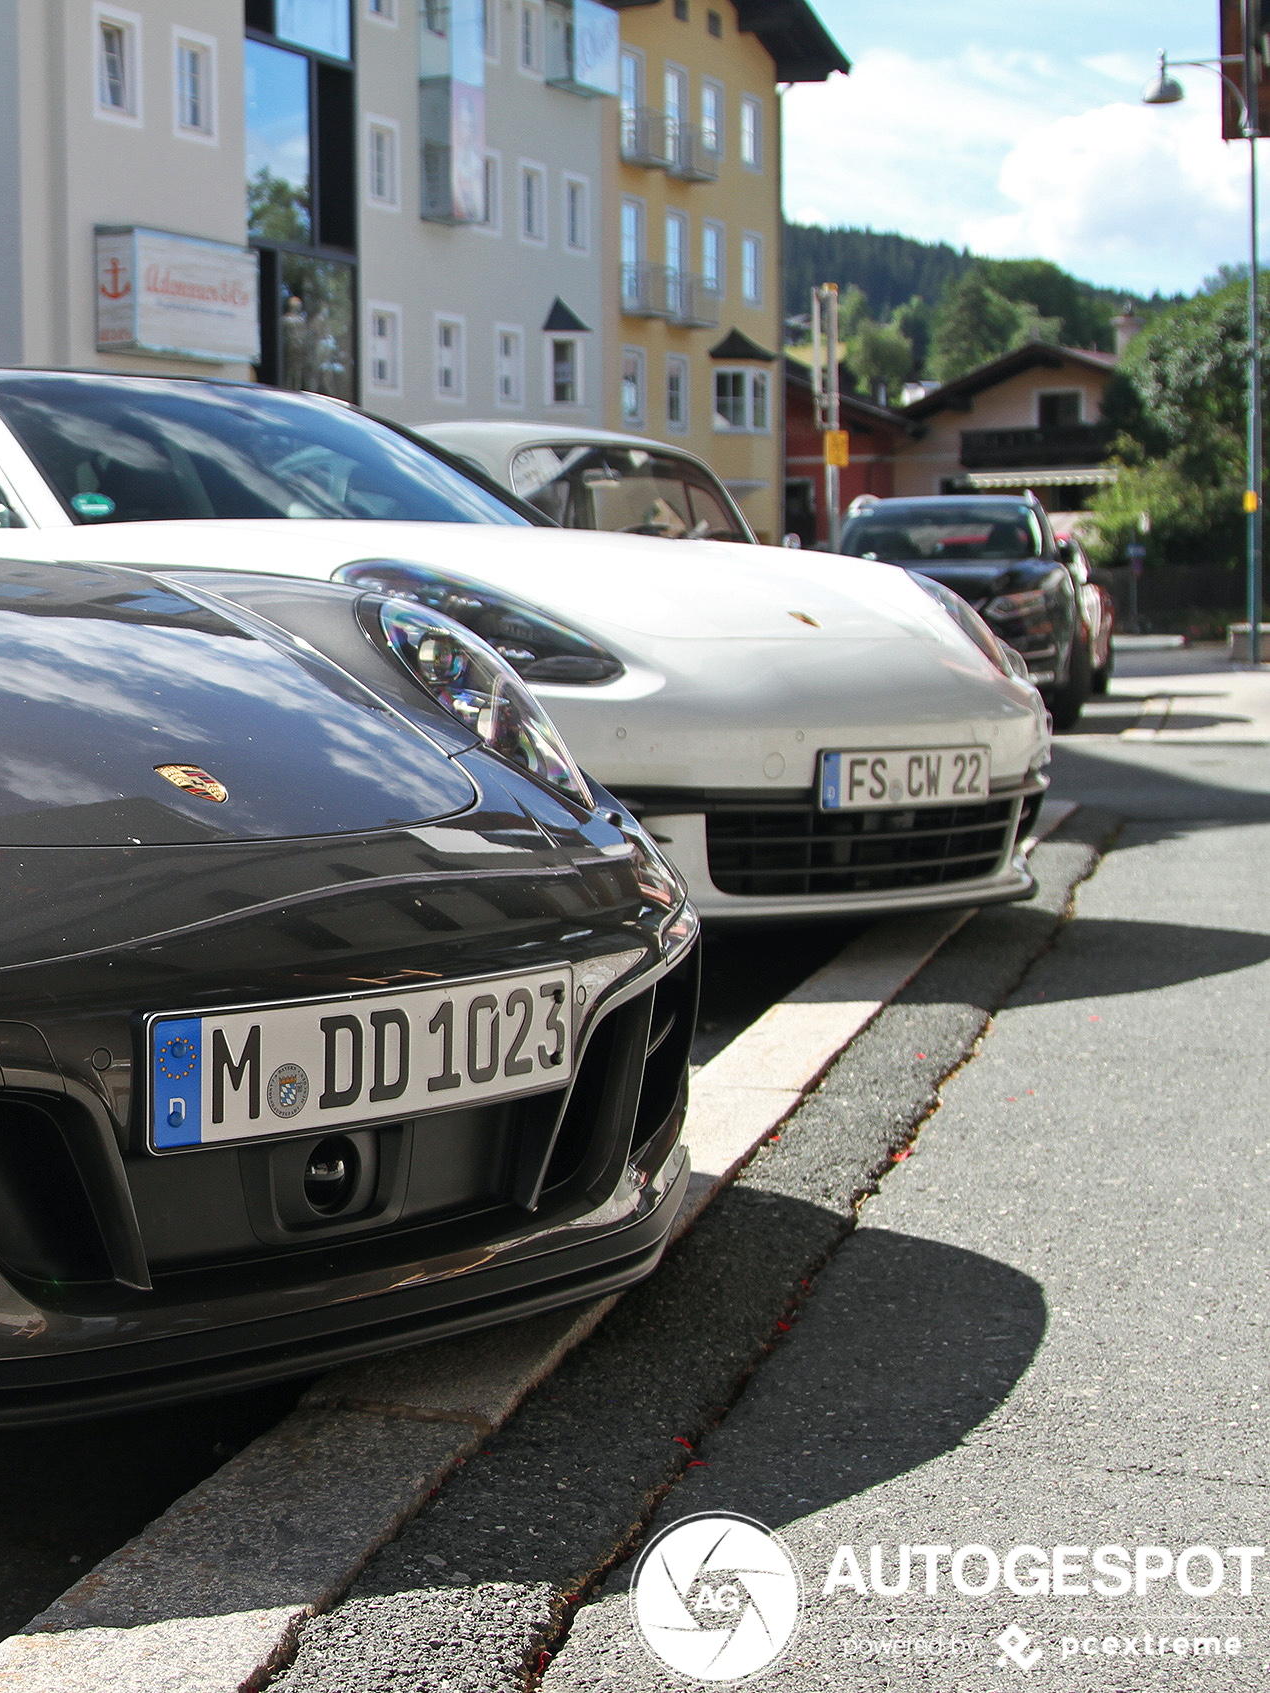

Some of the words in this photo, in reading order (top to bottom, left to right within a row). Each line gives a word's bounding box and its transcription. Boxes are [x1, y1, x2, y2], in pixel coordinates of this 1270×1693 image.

[849, 757, 887, 801] FS
[908, 755, 942, 797] CW
[953, 752, 981, 794] 22
[212, 1025, 260, 1124] M
[319, 1008, 410, 1109] DD
[427, 981, 566, 1092] 1023
